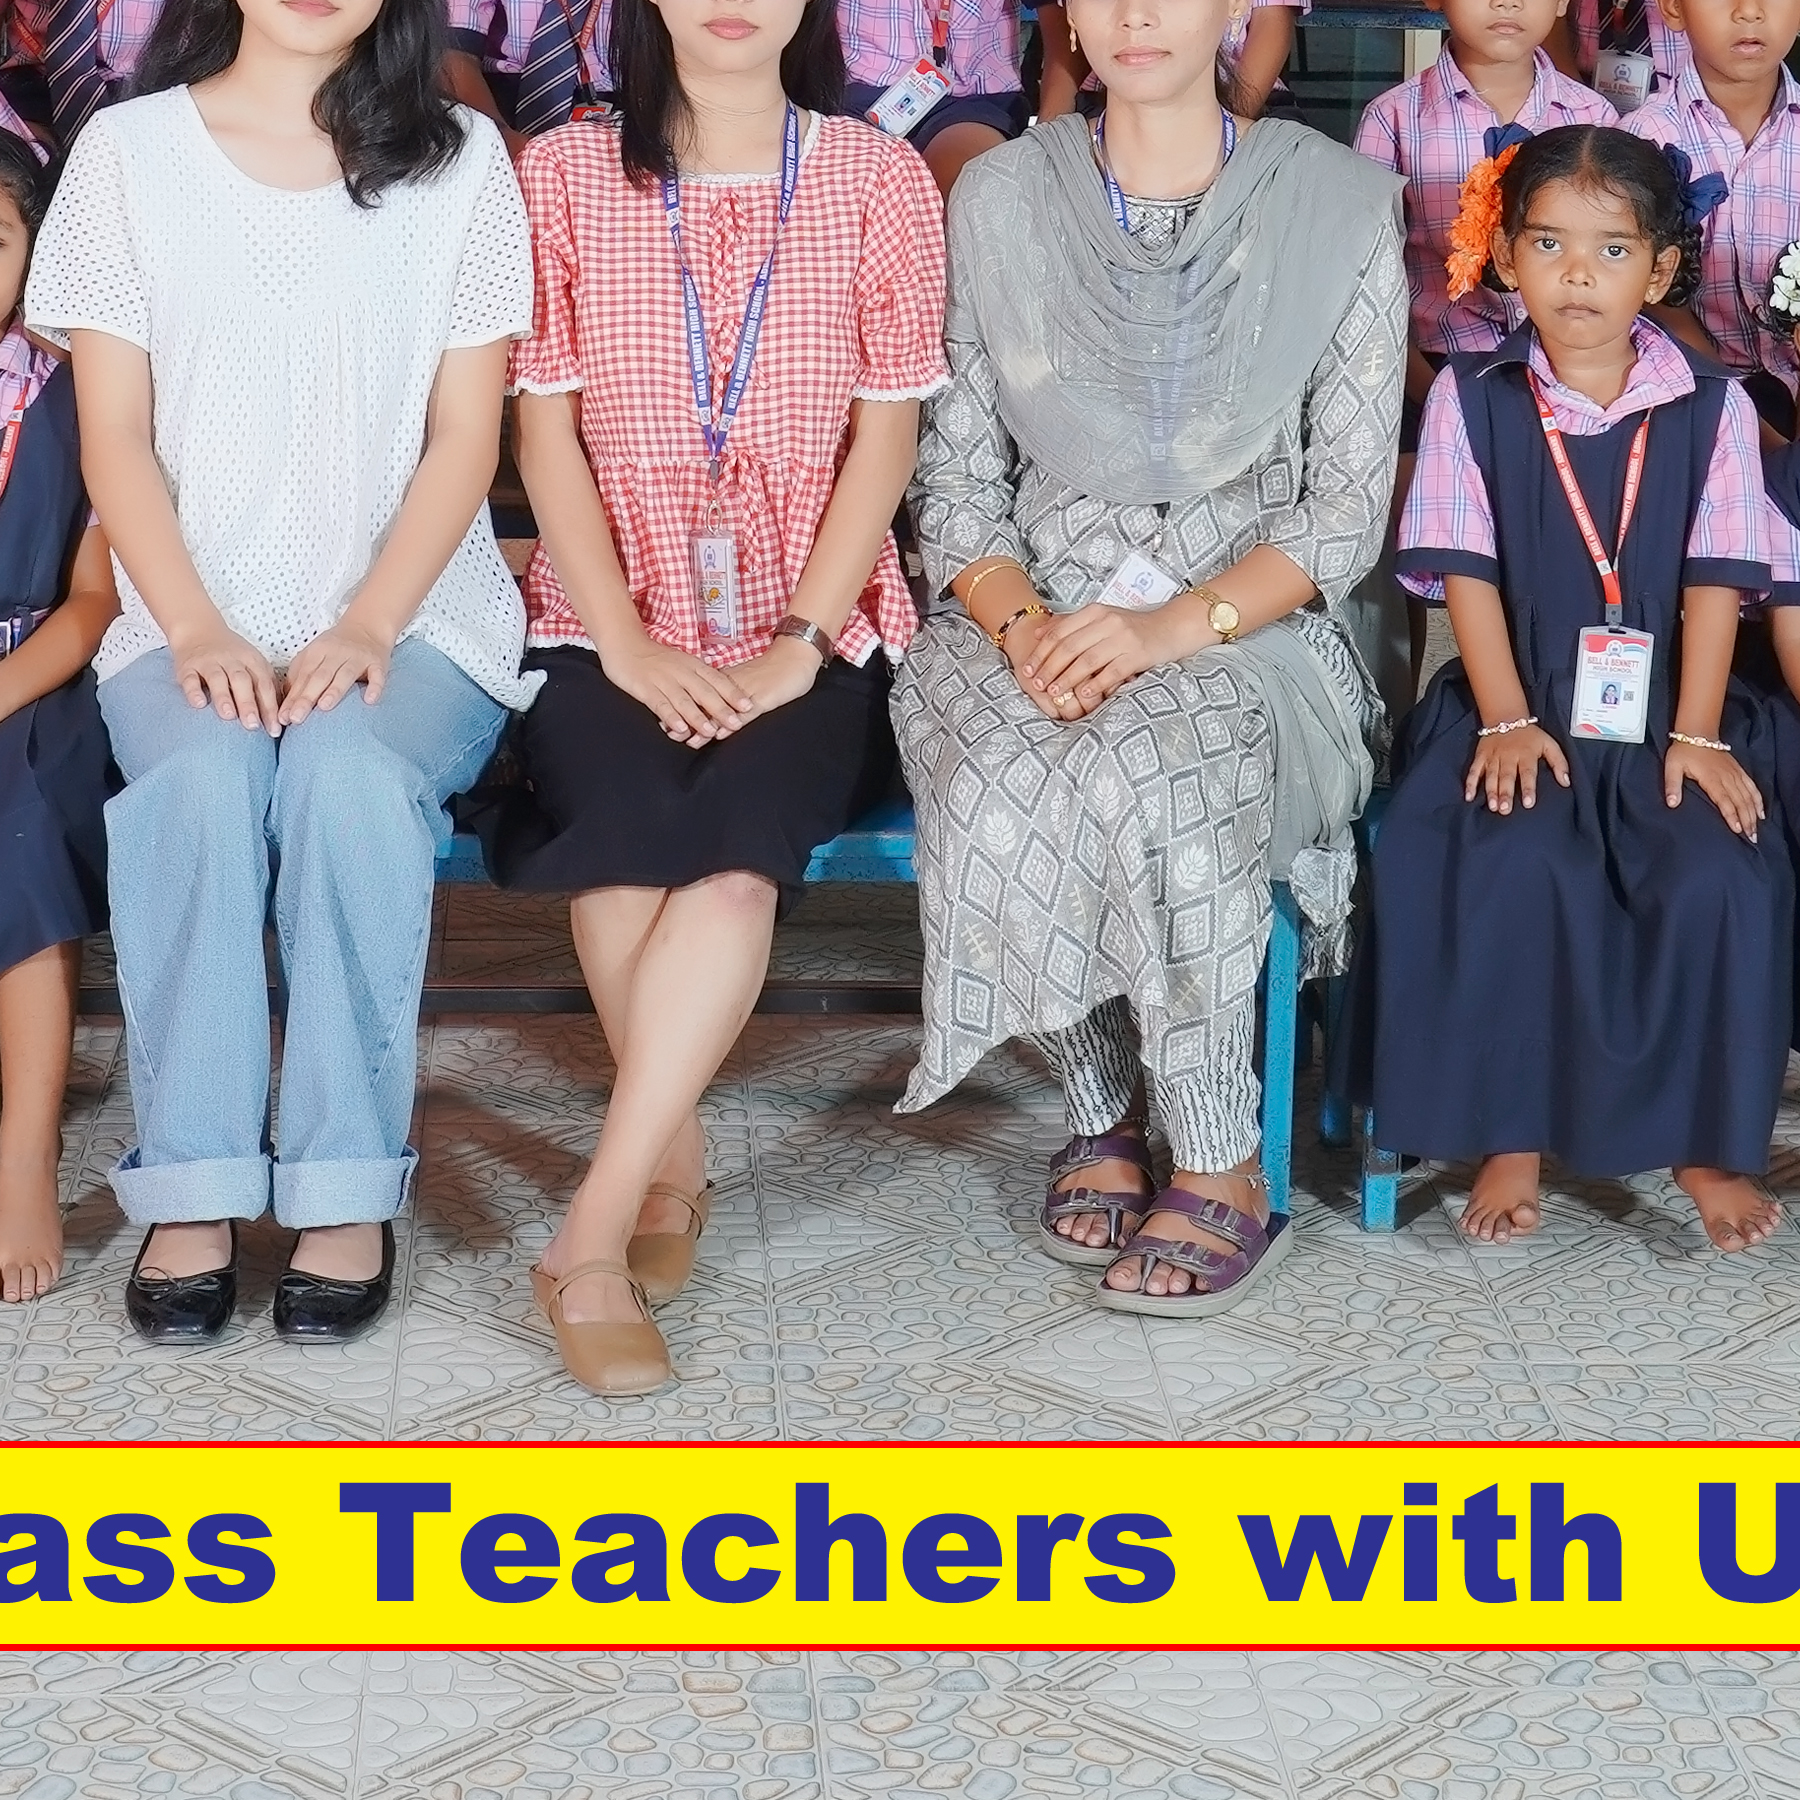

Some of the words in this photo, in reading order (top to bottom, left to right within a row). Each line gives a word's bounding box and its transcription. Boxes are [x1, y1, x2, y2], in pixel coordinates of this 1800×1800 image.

[686, 273, 698, 309] SCHOOL
[749, 283, 765, 318] SCHOOL
[690, 309, 701, 334] HIGH
[743, 316, 756, 342] HIGH
[692, 334, 705, 373] BENNETT
[735, 341, 752, 381] BENNETT
[698, 381, 707, 402] BELL
[727, 388, 738, 410] BELL
[1611, 659, 1639, 668] BENNETT
